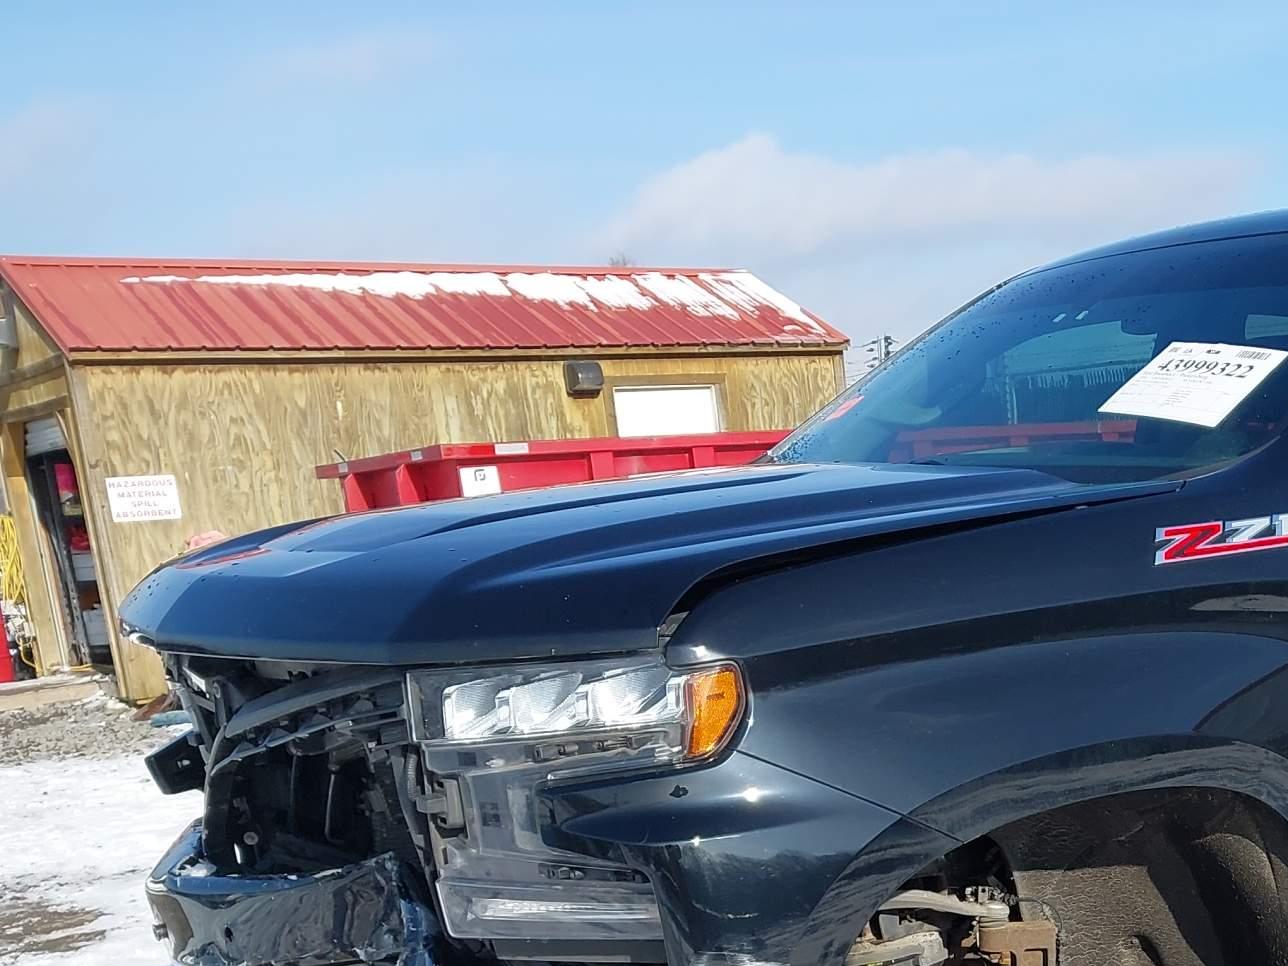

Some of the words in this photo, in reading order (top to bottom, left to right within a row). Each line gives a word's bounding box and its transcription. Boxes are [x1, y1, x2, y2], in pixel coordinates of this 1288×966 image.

[1157, 358, 1255, 379] 43999322
[108, 479, 173, 488] HAZARDOUS
[117, 490, 168, 498] MATERIAL
[116, 508, 177, 518] ABSORBENT
